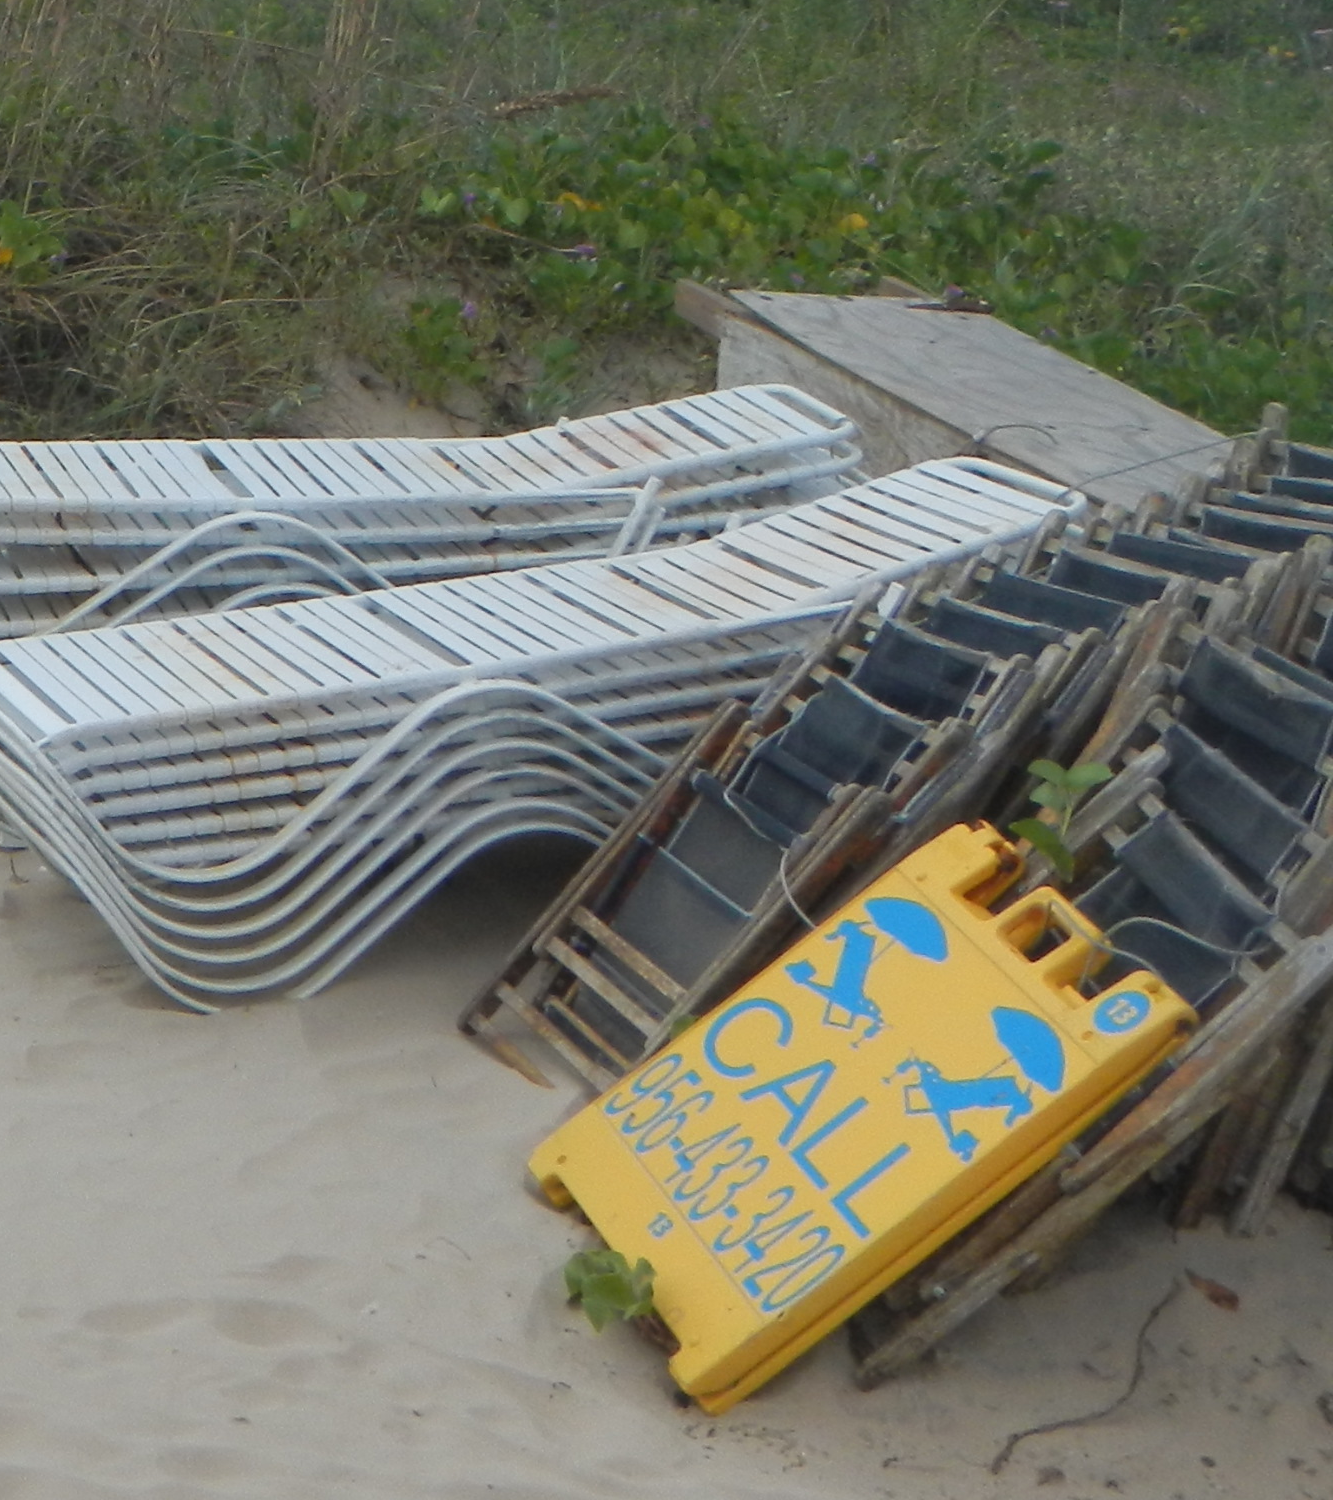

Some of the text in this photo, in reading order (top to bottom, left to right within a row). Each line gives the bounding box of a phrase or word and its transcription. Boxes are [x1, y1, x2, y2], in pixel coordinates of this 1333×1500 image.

[703, 997, 912, 1240] CALL
[1107, 999, 1138, 1025] 13
[603, 1052, 845, 1314] 956-433-3420
